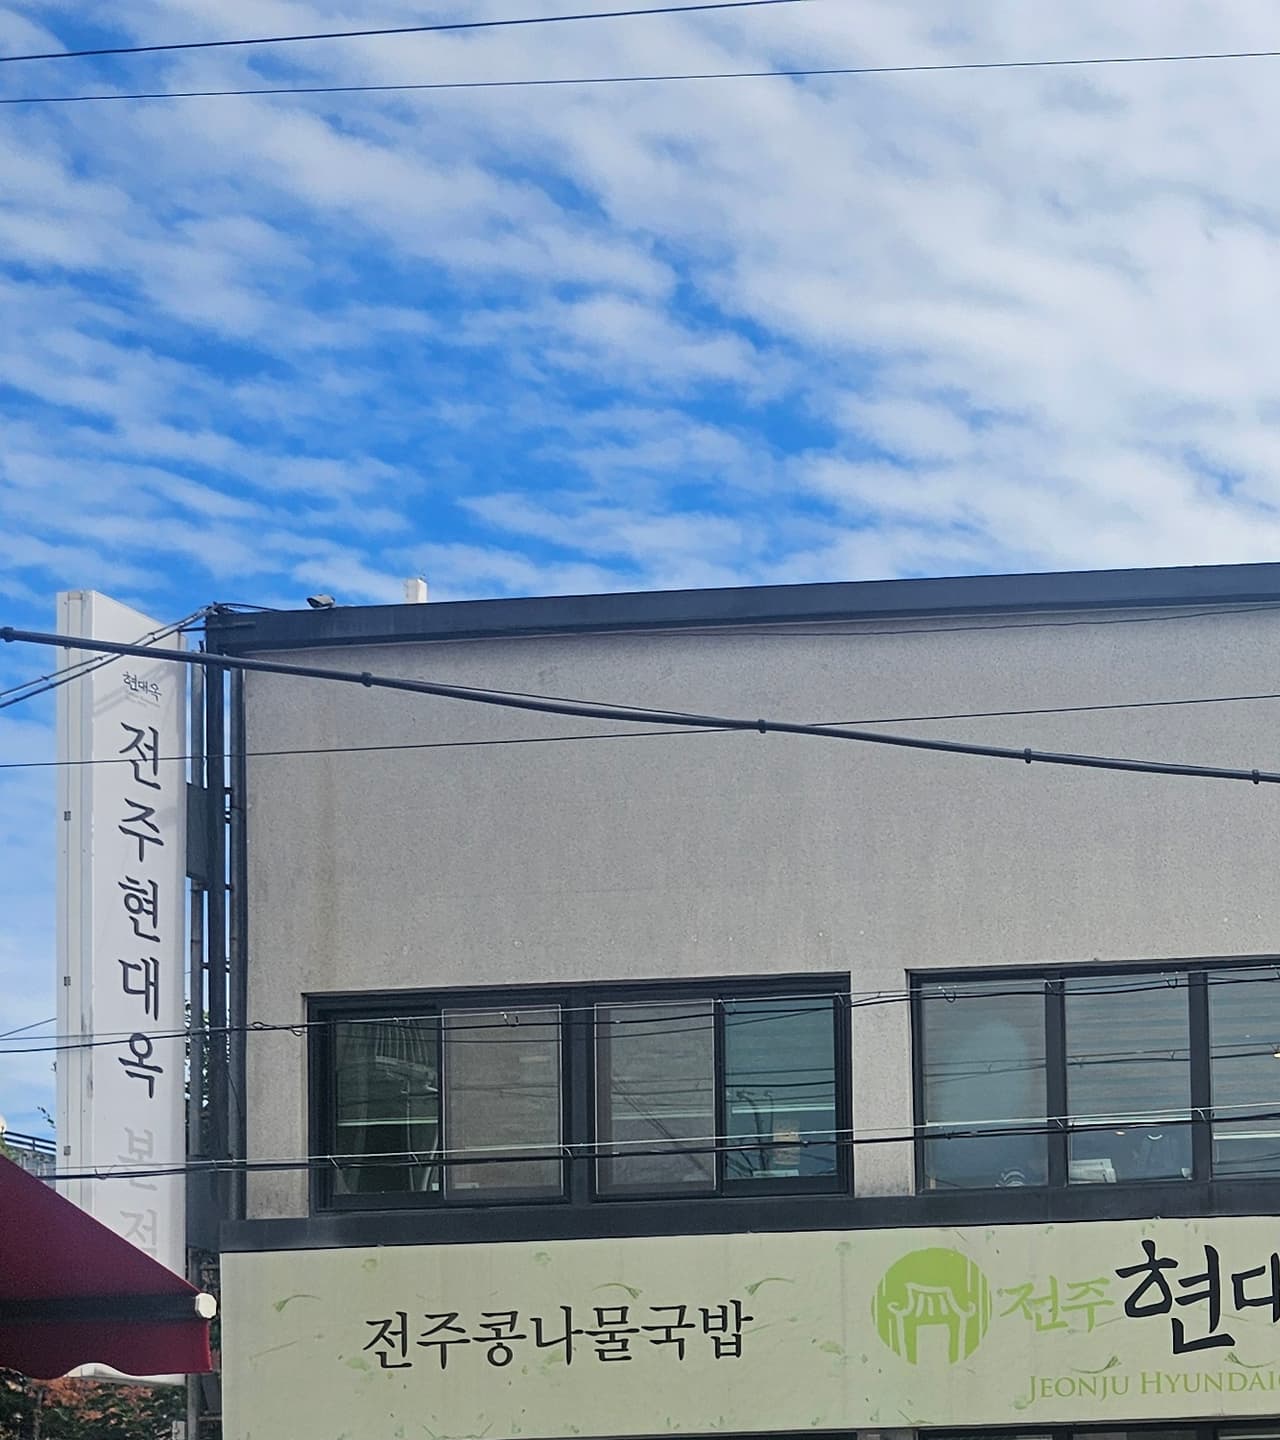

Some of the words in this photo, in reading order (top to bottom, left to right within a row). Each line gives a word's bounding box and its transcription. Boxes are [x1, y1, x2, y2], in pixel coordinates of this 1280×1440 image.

[122, 671, 163, 702] 현대옥
[118, 721, 164, 1099] 전주현대옥
[999, 1273, 1116, 1334] 전주
[363, 1299, 755, 1371] 전주콩나물국밥
[1028, 1372, 1131, 1404] JEONJU
